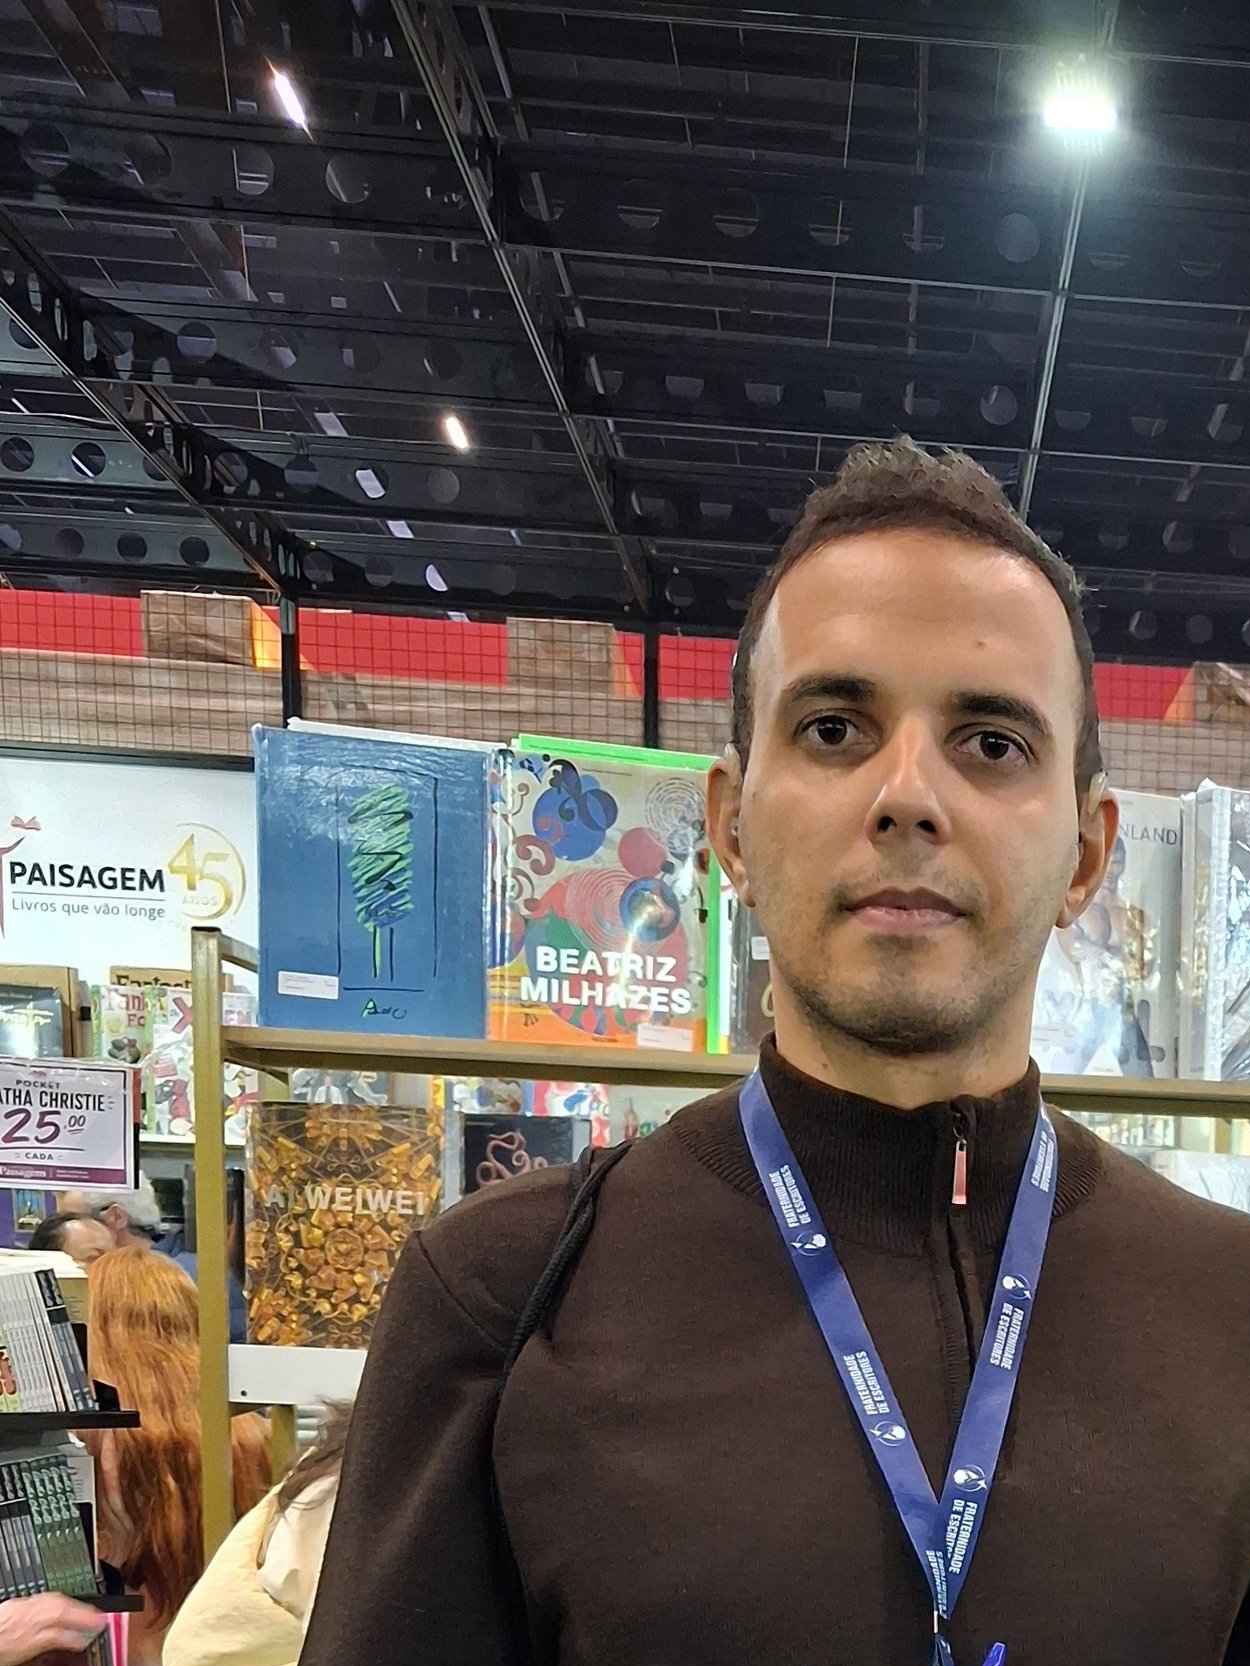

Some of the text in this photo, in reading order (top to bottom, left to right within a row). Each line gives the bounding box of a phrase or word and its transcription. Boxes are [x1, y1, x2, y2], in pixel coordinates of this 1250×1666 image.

[9, 861, 166, 893] PAISAGEM
[12, 898, 166, 921] Livros que vão longe
[536, 946, 677, 983] BEATRIZ
[520, 976, 692, 1015] MILHAZES
[16, 1079, 61, 1090] POCKET
[39, 1090, 106, 1112] CHRISTIE
[25, 1152, 54, 1161] CADA
[304, 1181, 428, 1216] WEIWEI
[769, 1171, 800, 1228] FRATERNIDADE
[798, 1212, 812, 1225] DE
[990, 1302, 1013, 1366] DE ESCRITORES
[1000, 1307, 1025, 1370] FRATERNIDADE
[843, 1354, 878, 1415] FRATERNIDADE
[855, 1350, 890, 1414] DE ESCRITORES
[952, 1499, 965, 1512] DE
[949, 1501, 978, 1575] FRATERNIDADE
